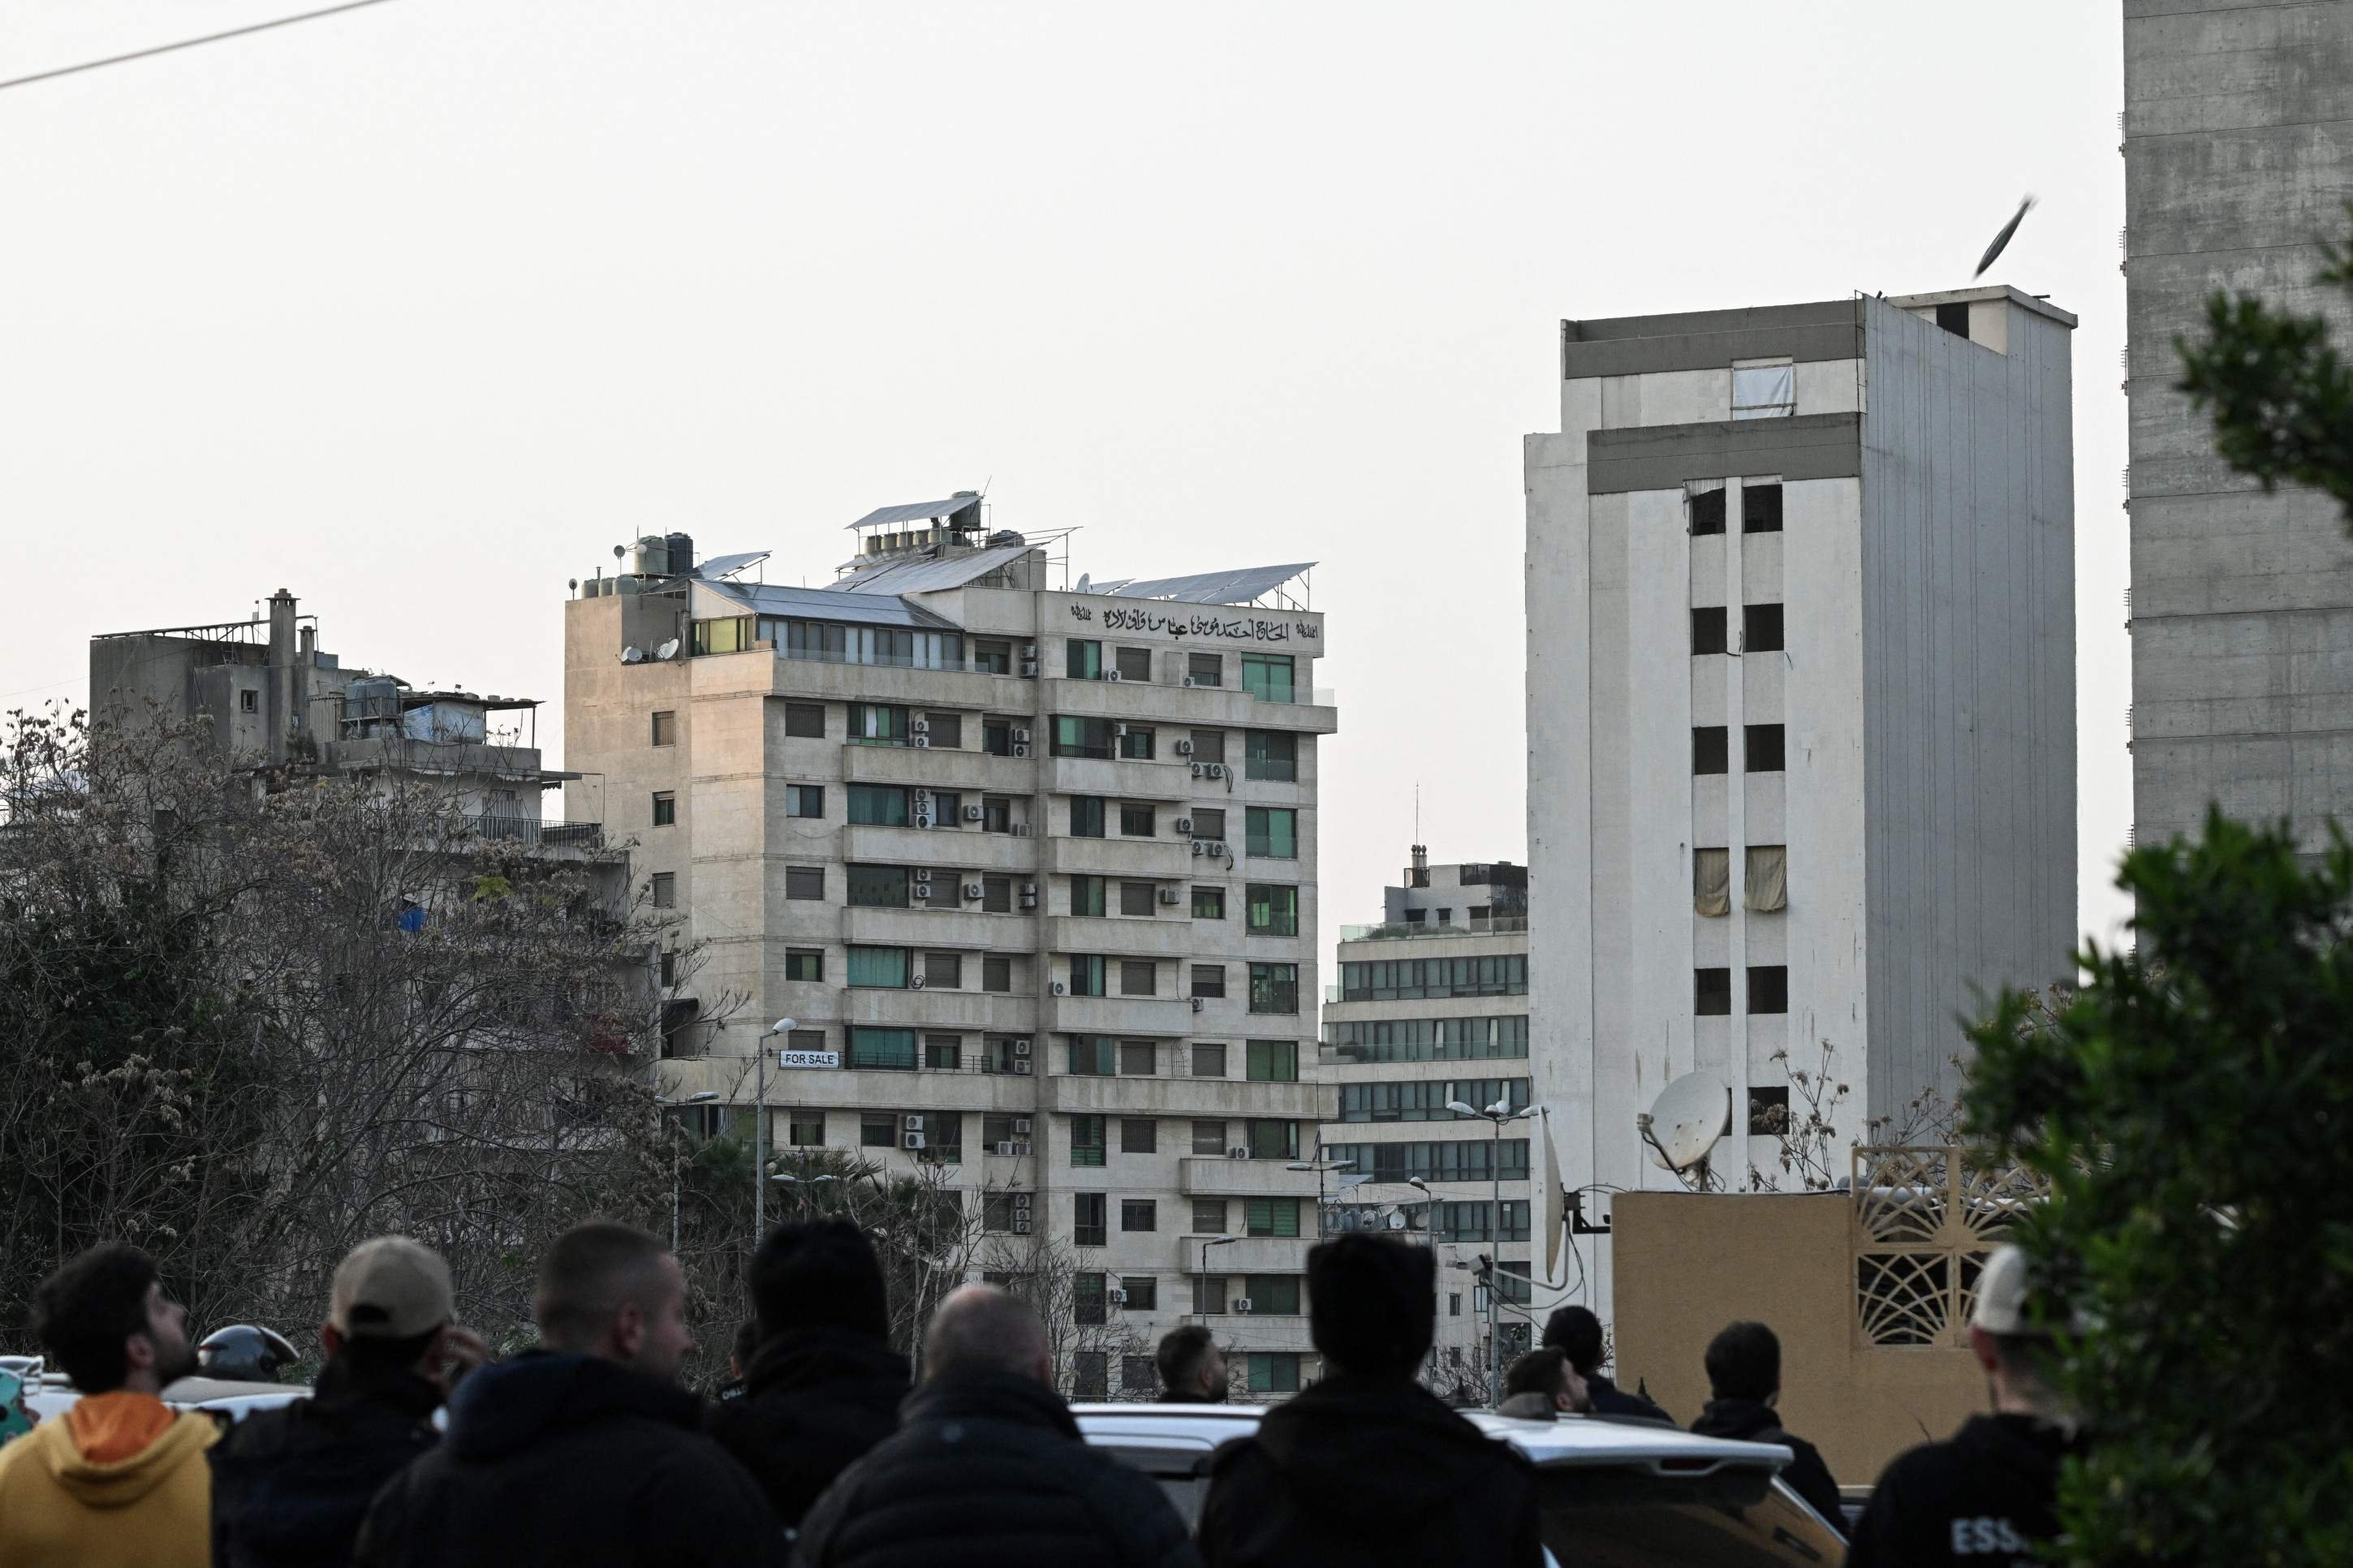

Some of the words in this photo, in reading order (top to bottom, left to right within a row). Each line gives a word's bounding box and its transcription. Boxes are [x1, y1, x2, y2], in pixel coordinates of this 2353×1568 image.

[1148, 613, 1187, 640] عباس
[1190, 615, 1219, 636] موسى
[1217, 618, 1255, 640] أحمد
[1256, 621, 1289, 641] الحاج
[786, 1053, 806, 1064] FOR
[808, 1054, 834, 1064] SALE
[1950, 1515, 2032, 1555] ESS
